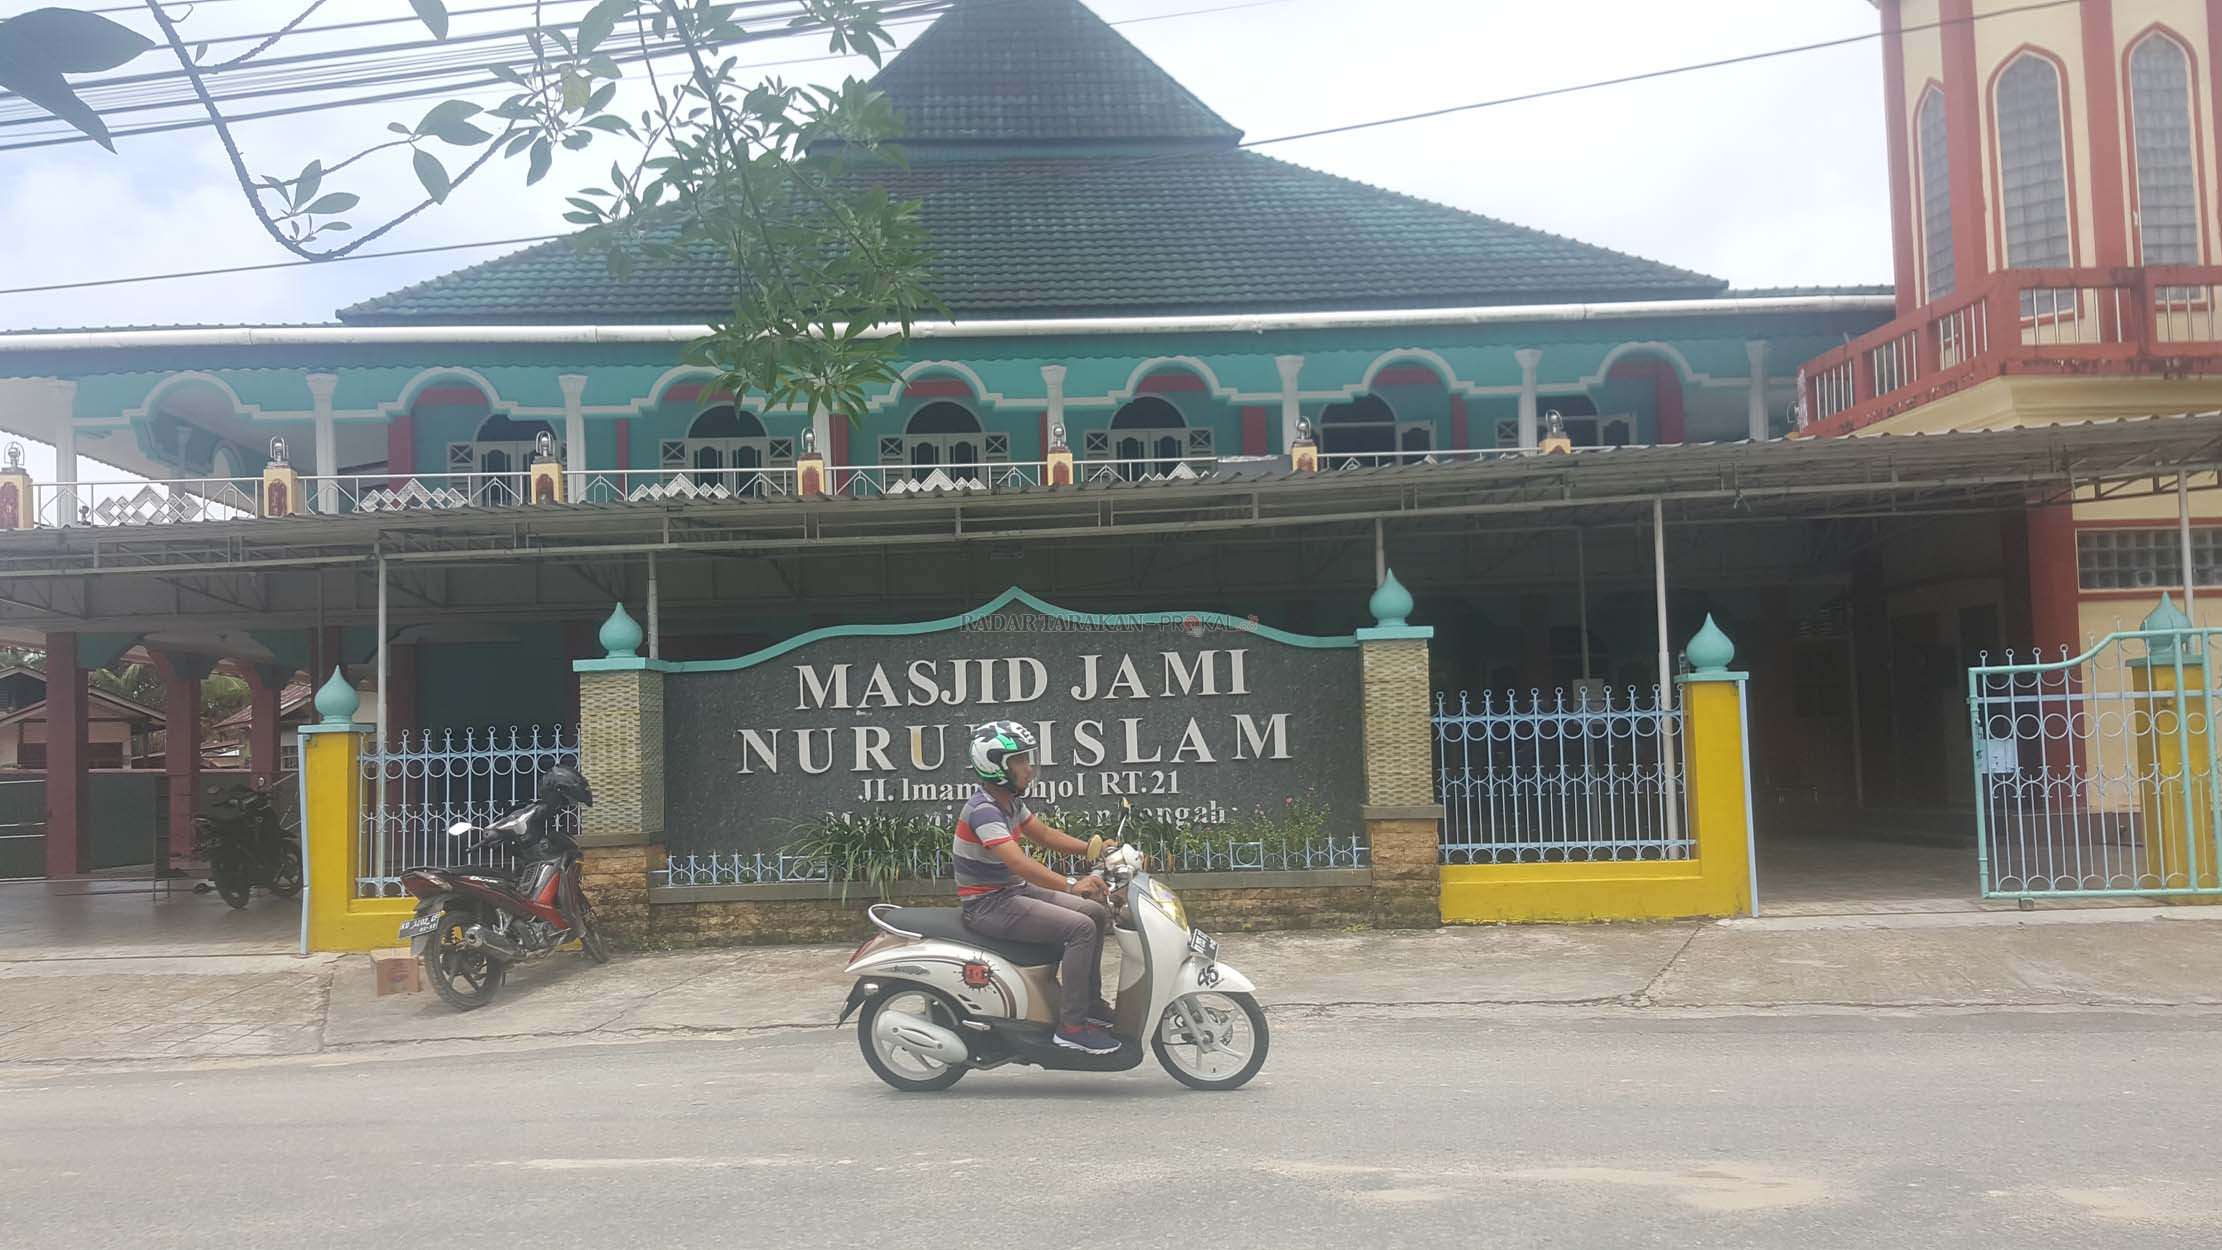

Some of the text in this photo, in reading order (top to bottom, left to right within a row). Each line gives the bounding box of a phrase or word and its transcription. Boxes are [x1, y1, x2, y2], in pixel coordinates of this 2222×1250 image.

[793, 649, 1251, 710] MASJID JAMI
[736, 713, 1293, 774] NURU ISLAM
[1101, 770, 1181, 796] RT.21
